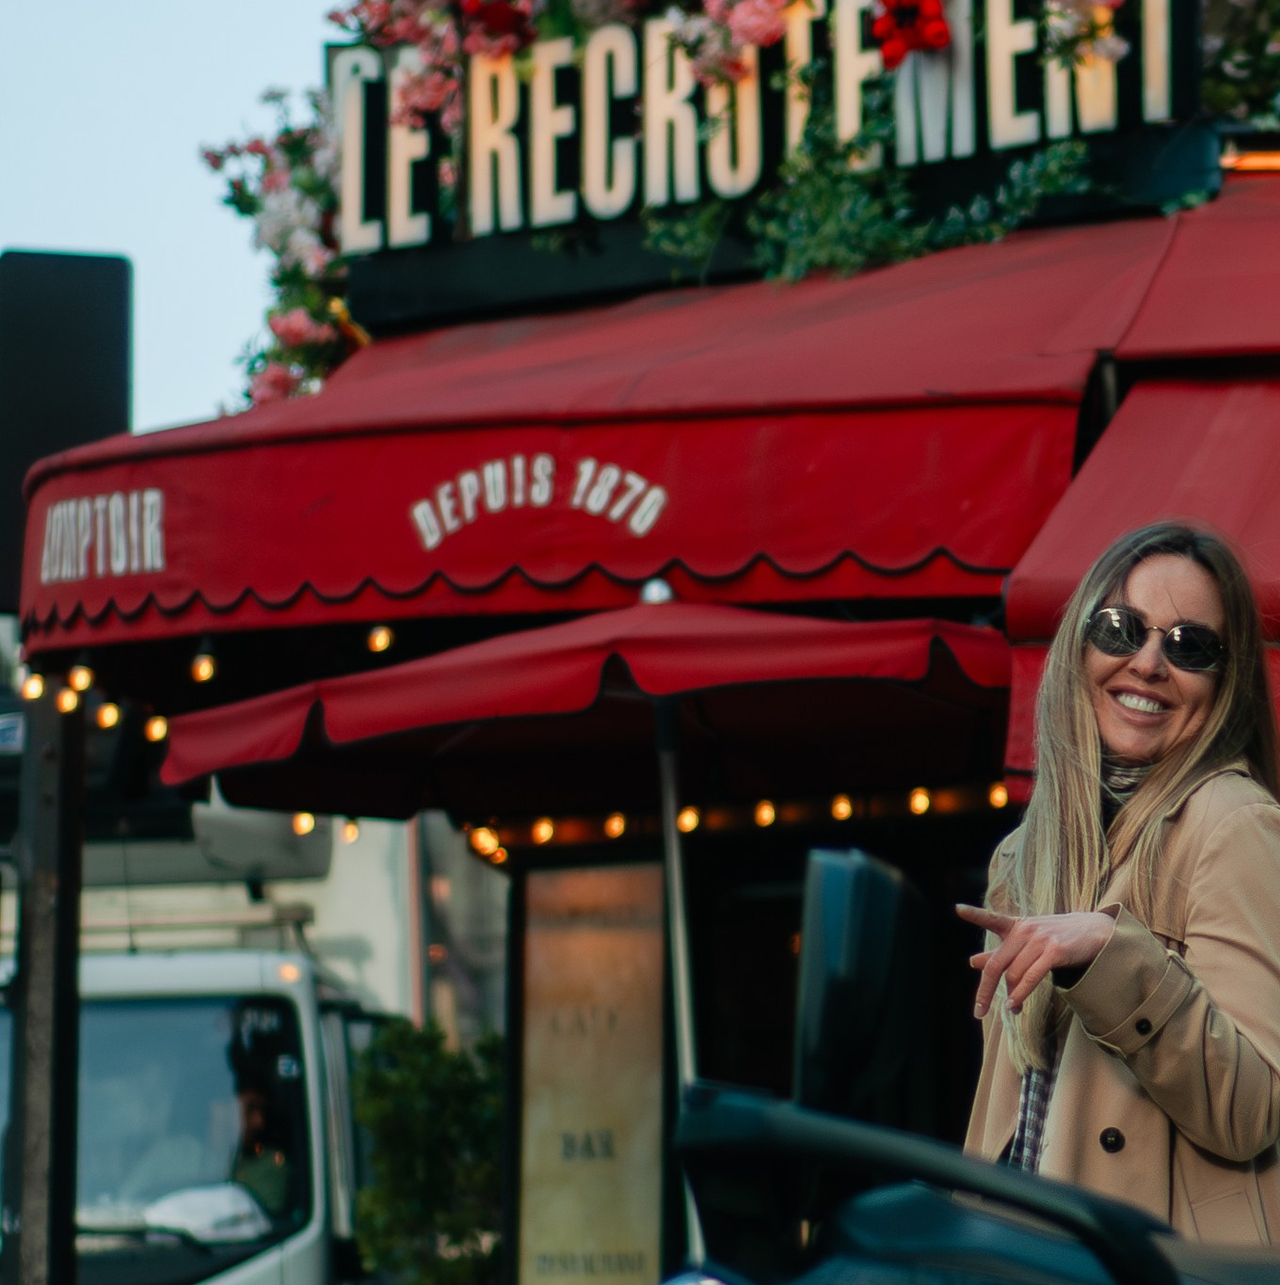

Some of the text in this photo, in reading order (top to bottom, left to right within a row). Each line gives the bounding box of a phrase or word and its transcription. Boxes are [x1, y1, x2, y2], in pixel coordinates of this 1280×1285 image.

[335, 46, 430, 256] LE
[411, 453, 667, 551] DEPUIS 1870
